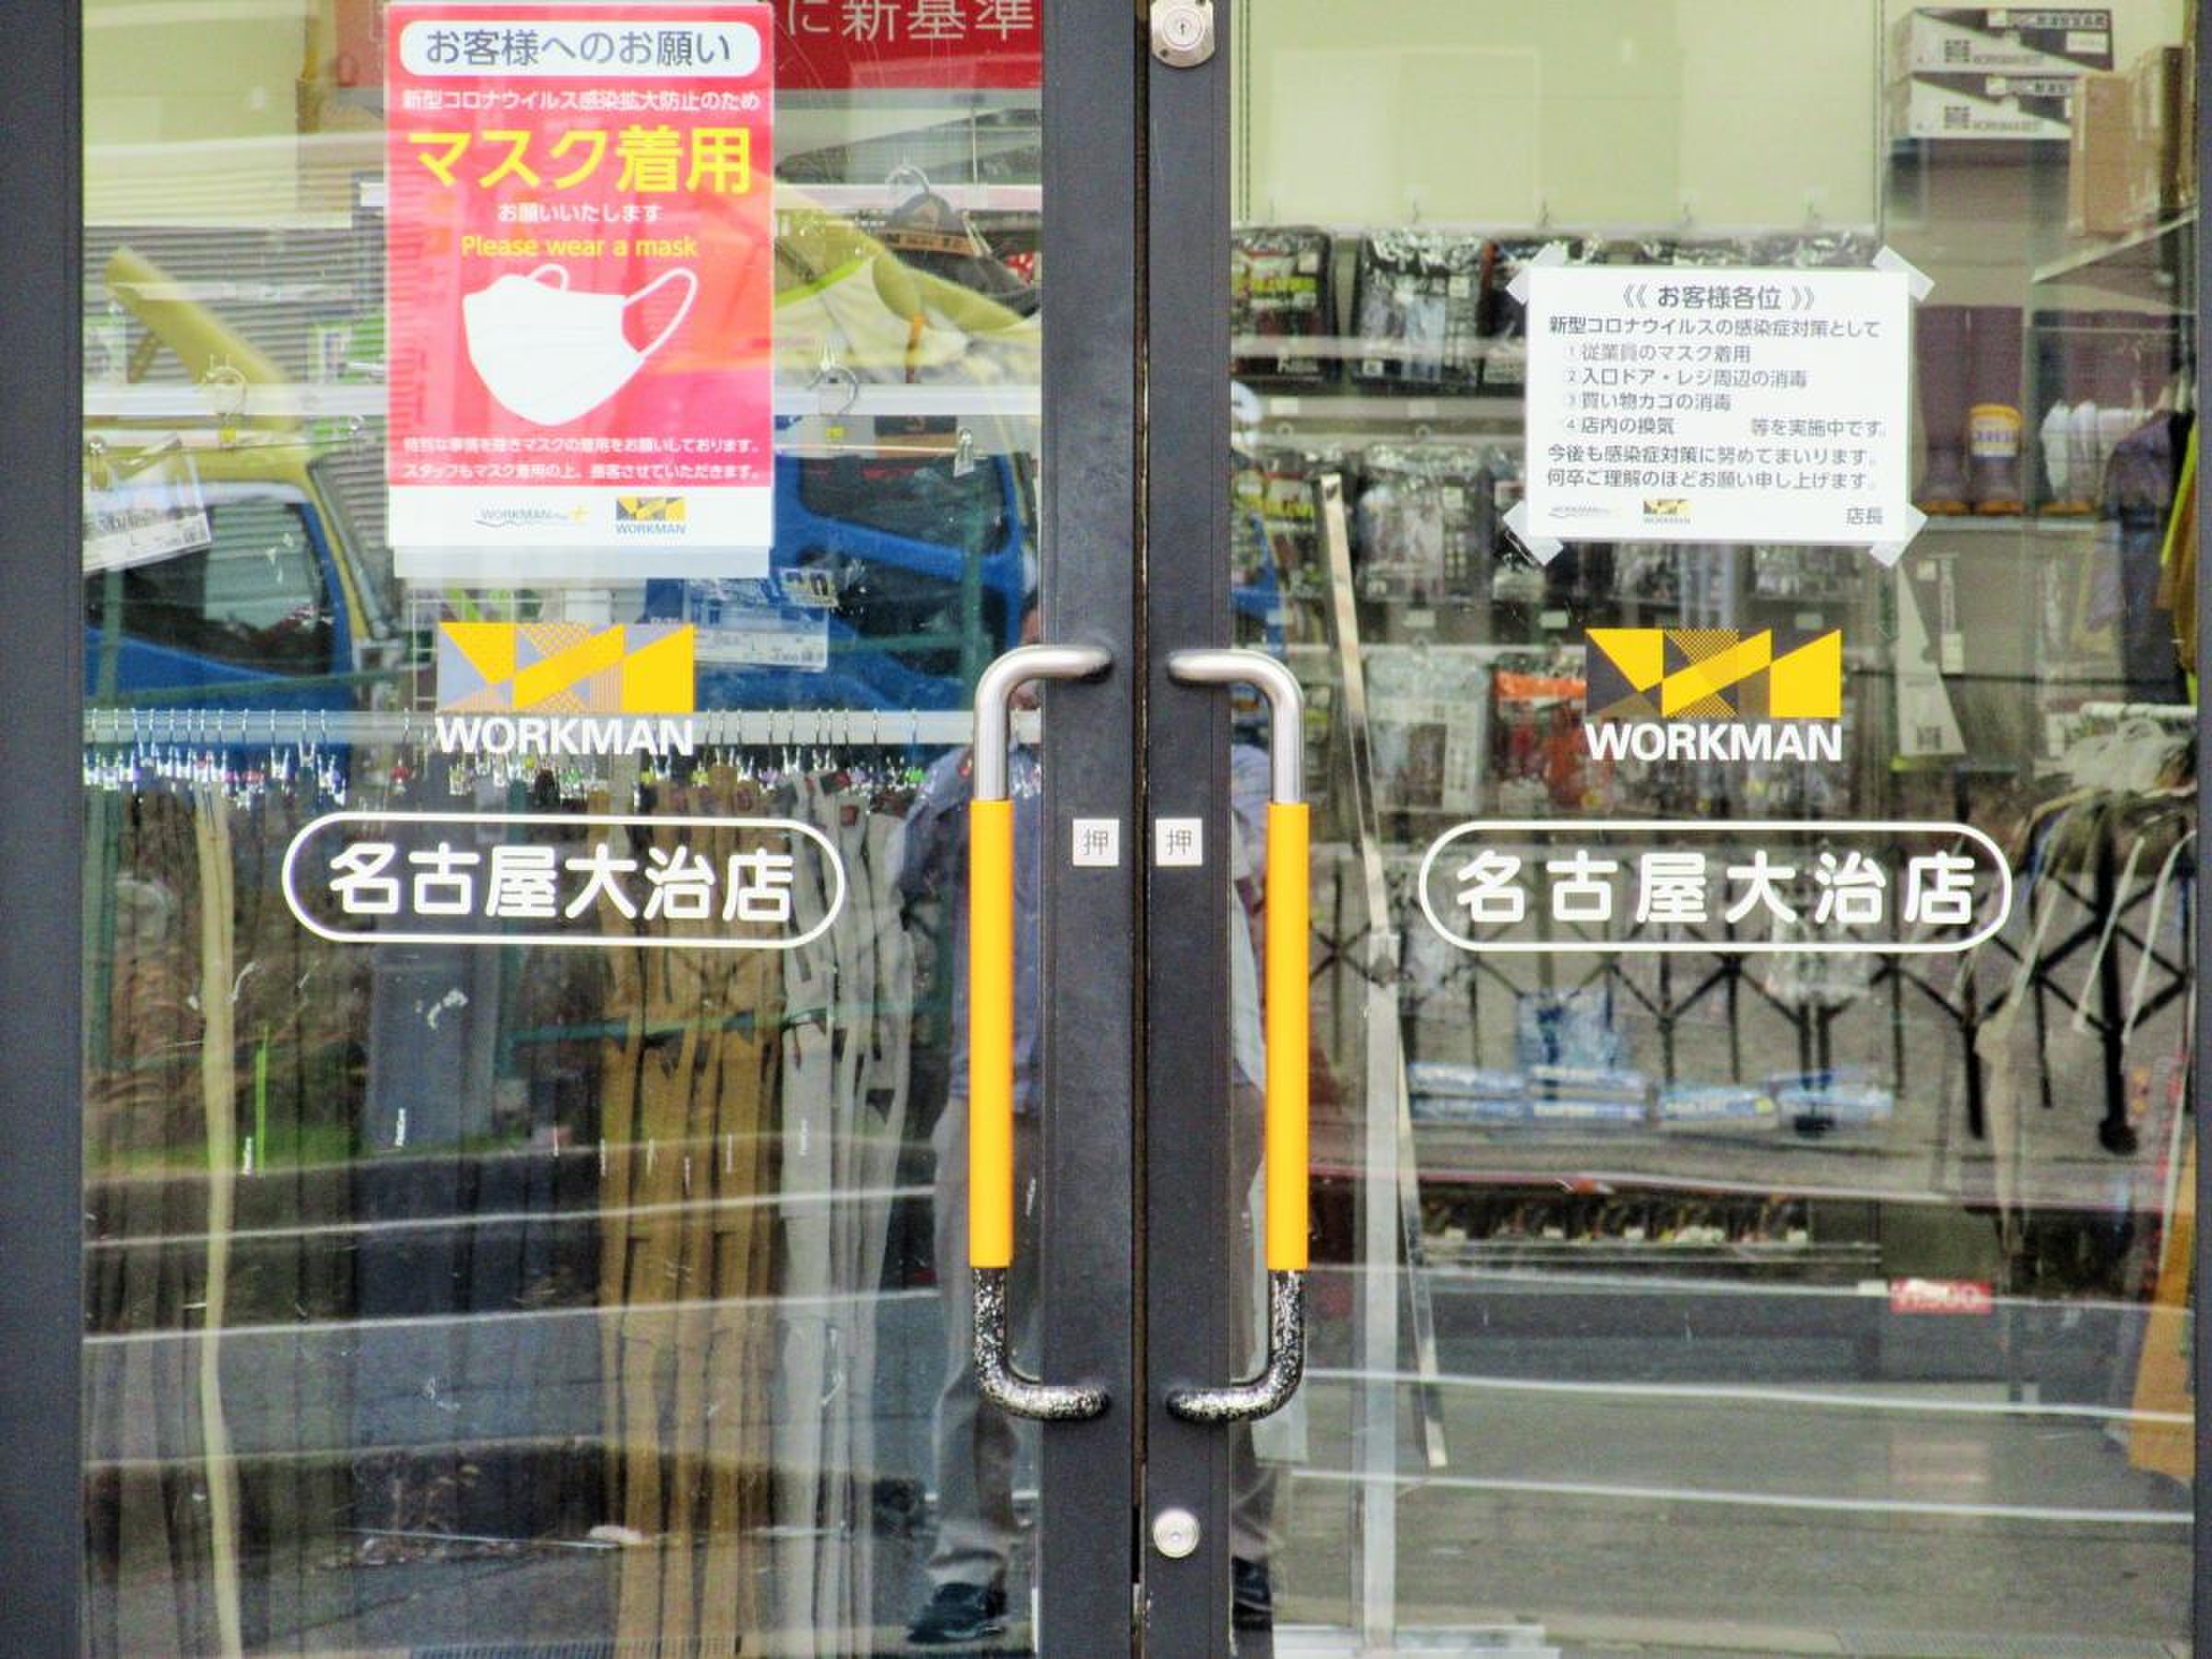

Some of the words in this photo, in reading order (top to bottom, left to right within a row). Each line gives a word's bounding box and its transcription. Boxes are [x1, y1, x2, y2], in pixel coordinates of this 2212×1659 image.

[427, 29, 731, 66] お客様へのお願い
[403, 89, 760, 111] 新型コロナウイルス感染拡大防止のため
[408, 124, 751, 194] マスク着用
[499, 203, 663, 223] お願いいたします
[462, 236, 537, 258] Please
[547, 240, 605, 258] wear
[612, 240, 628, 258] a
[636, 236, 698, 258] mask
[1658, 285, 1782, 311] お客様各位
[1548, 316, 1882, 338] 新型コロナウイルスの感染症対策として
[1547, 443, 1877, 465] 今後も感染症対策に努めてまいります。
[1547, 468, 1877, 489] 何卒ご理解のほどお願い申し上げます。
[1846, 507, 1884, 525] 店長
[615, 524, 687, 535] WORKMAN
[435, 717, 694, 757] WORKMAN
[1585, 724, 1842, 762] WORKMAN
[1084, 828, 1109, 856] 押
[1166, 828, 1192, 856] 押
[329, 842, 794, 923] 名古屋大治店
[1456, 850, 1976, 924] 名古屋大治店
